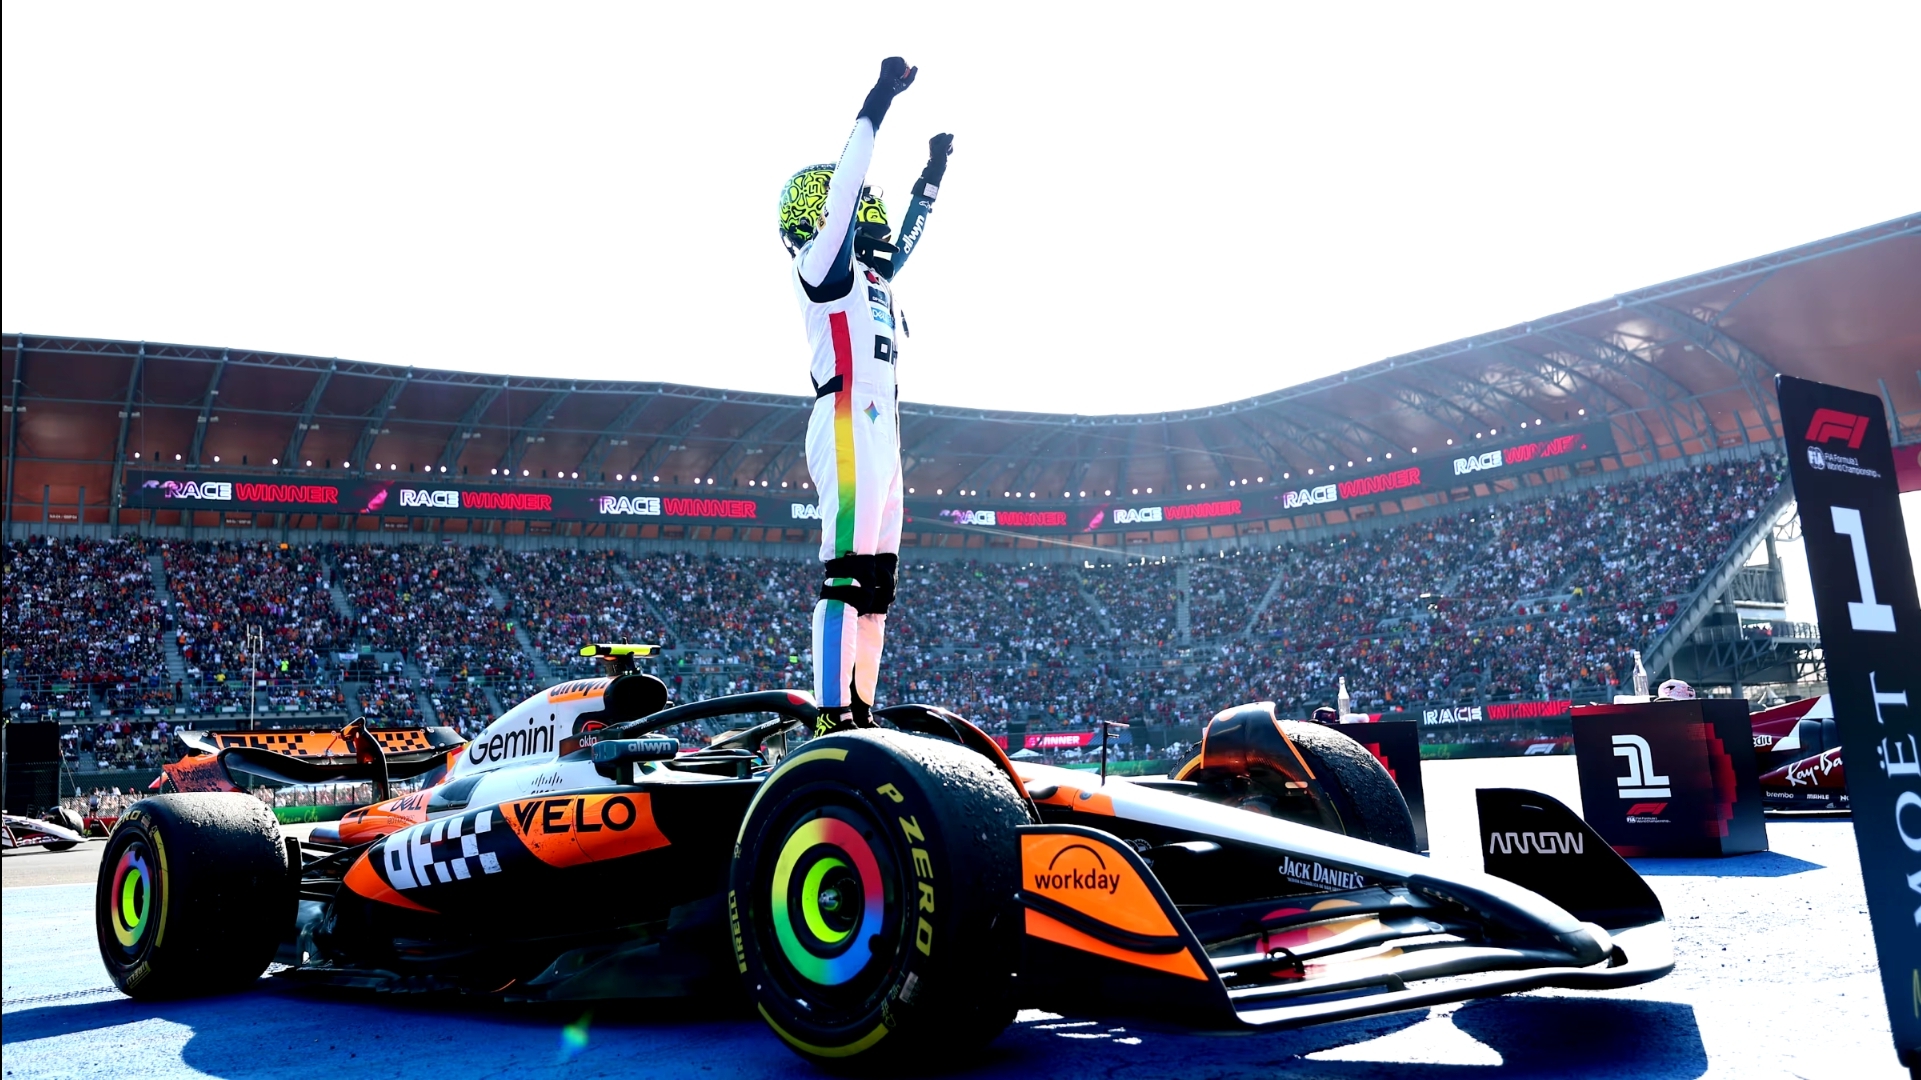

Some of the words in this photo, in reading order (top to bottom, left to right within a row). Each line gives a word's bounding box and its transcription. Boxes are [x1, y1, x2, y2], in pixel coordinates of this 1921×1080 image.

[1453, 450, 1503, 475] RACE
[164, 481, 232, 501] RACE
[235, 483, 338, 504] WINNER
[1283, 484, 1337, 509] RACE
[1338, 467, 1421, 499] WINNER
[400, 489, 459, 508] RACE
[462, 491, 552, 511] WINNER
[600, 496, 661, 516] RACE
[663, 498, 757, 518] WINNER
[791, 503, 823, 520] RAC
[953, 510, 996, 526] RACE
[996, 511, 1067, 526] WINNER
[1113, 507, 1162, 524] RACE
[1163, 500, 1242, 520] WINNER
[1830, 506, 1896, 632] 1
[1423, 706, 1482, 725] RACE
[469, 713, 555, 766] Gemini
[579, 734, 598, 748] okta
[628, 740, 671, 755] allwyn
[1611, 735, 1671, 798] 1
[1766, 791, 1794, 799] brembo
[513, 796, 637, 836] VELO
[1490, 832, 1583, 854] ARROW
[876, 783, 904, 803] P
[898, 815, 935, 956] ZERO
[1035, 868, 1120, 894] workday
[1279, 856, 1311, 880] JACK
[1312, 862, 1364, 889] DANIEL'S
